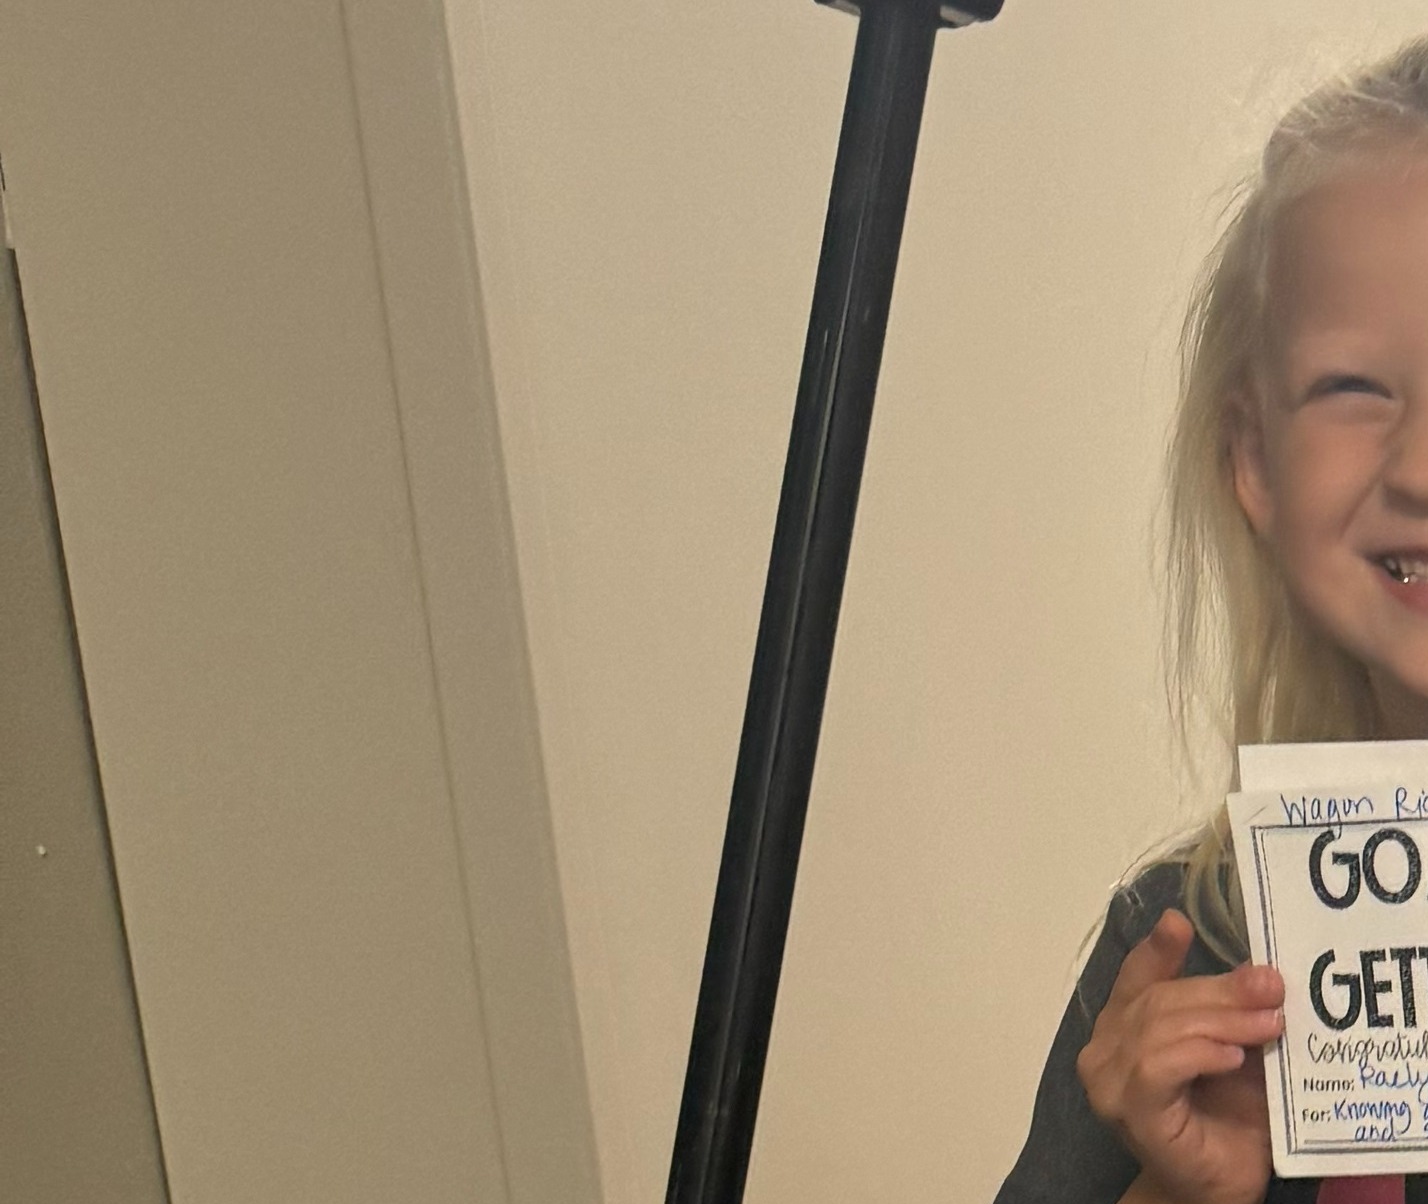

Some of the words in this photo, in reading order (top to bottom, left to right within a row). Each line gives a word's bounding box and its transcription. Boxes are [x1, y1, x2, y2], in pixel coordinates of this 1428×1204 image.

[1281, 793, 1374, 840] Wagon
[1303, 1077, 1355, 1092] Name:
[1302, 1108, 1331, 1122] For:
[1355, 1117, 1398, 1142] and
